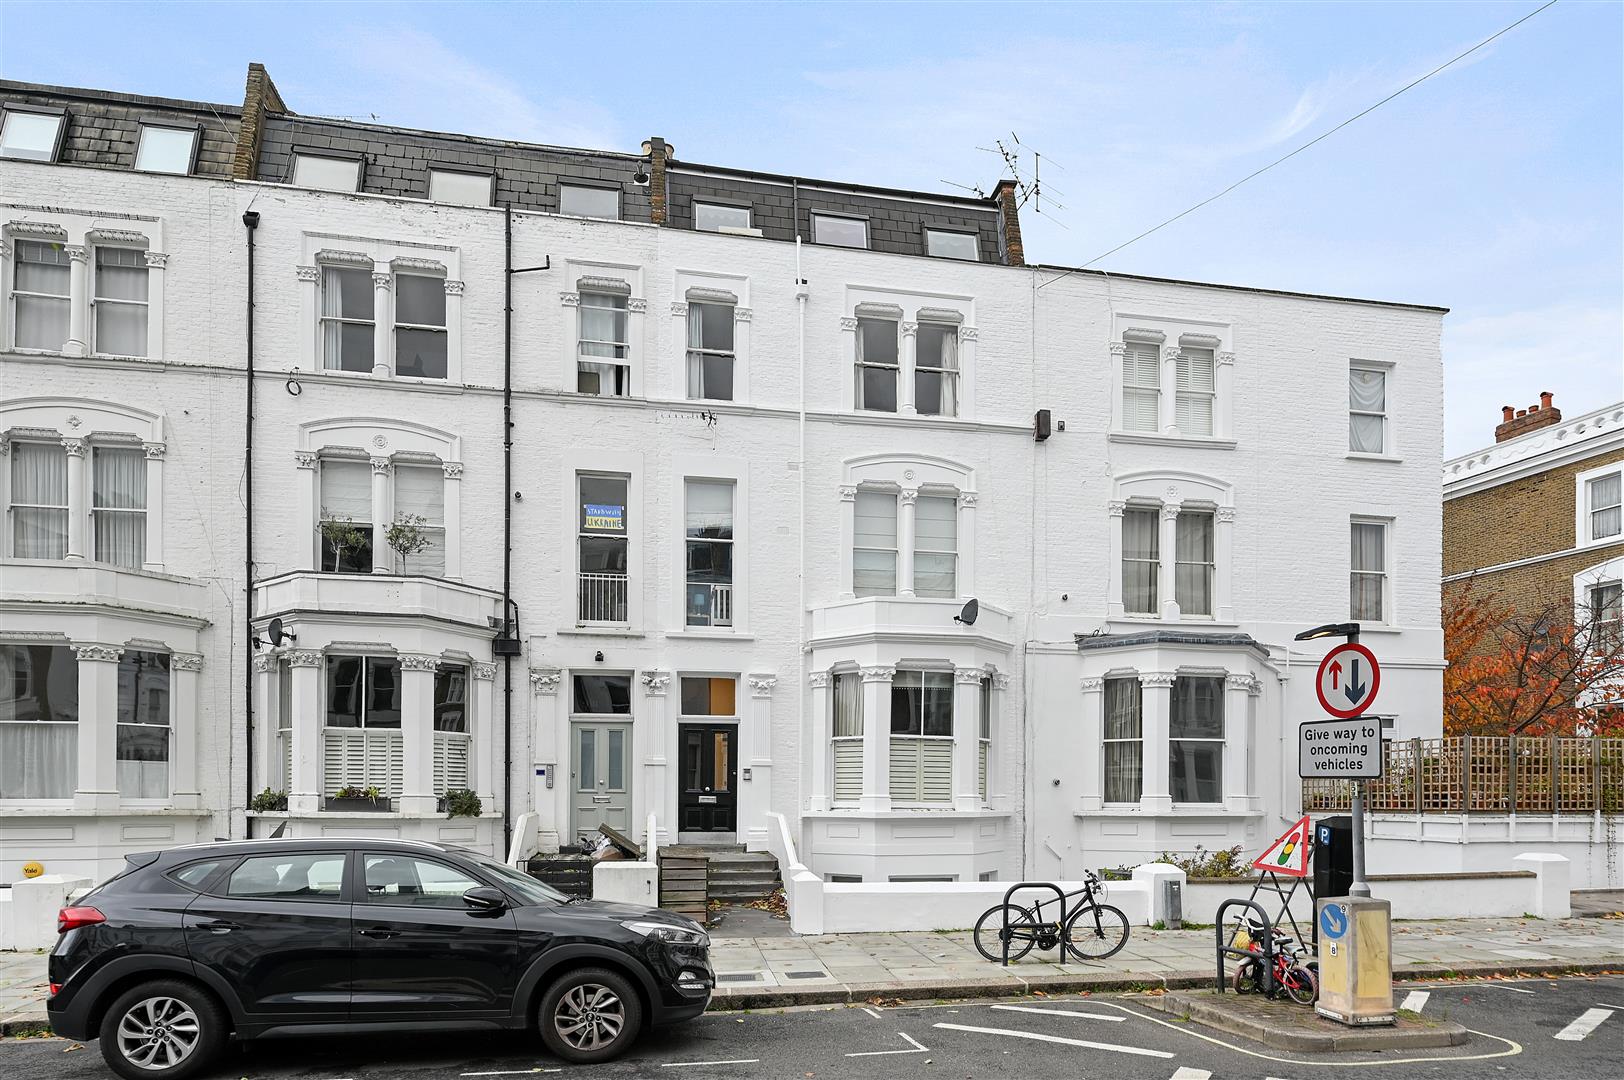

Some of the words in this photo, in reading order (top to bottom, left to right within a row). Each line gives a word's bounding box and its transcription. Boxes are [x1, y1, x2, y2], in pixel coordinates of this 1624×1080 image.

[1305, 729, 1329, 741] Give
[1333, 729, 1357, 740] way
[1361, 726, 1375, 738] to
[1310, 743, 1368, 756] oncoming
[1314, 758, 1363, 770] vehicles
[1321, 828, 1328, 842] P
